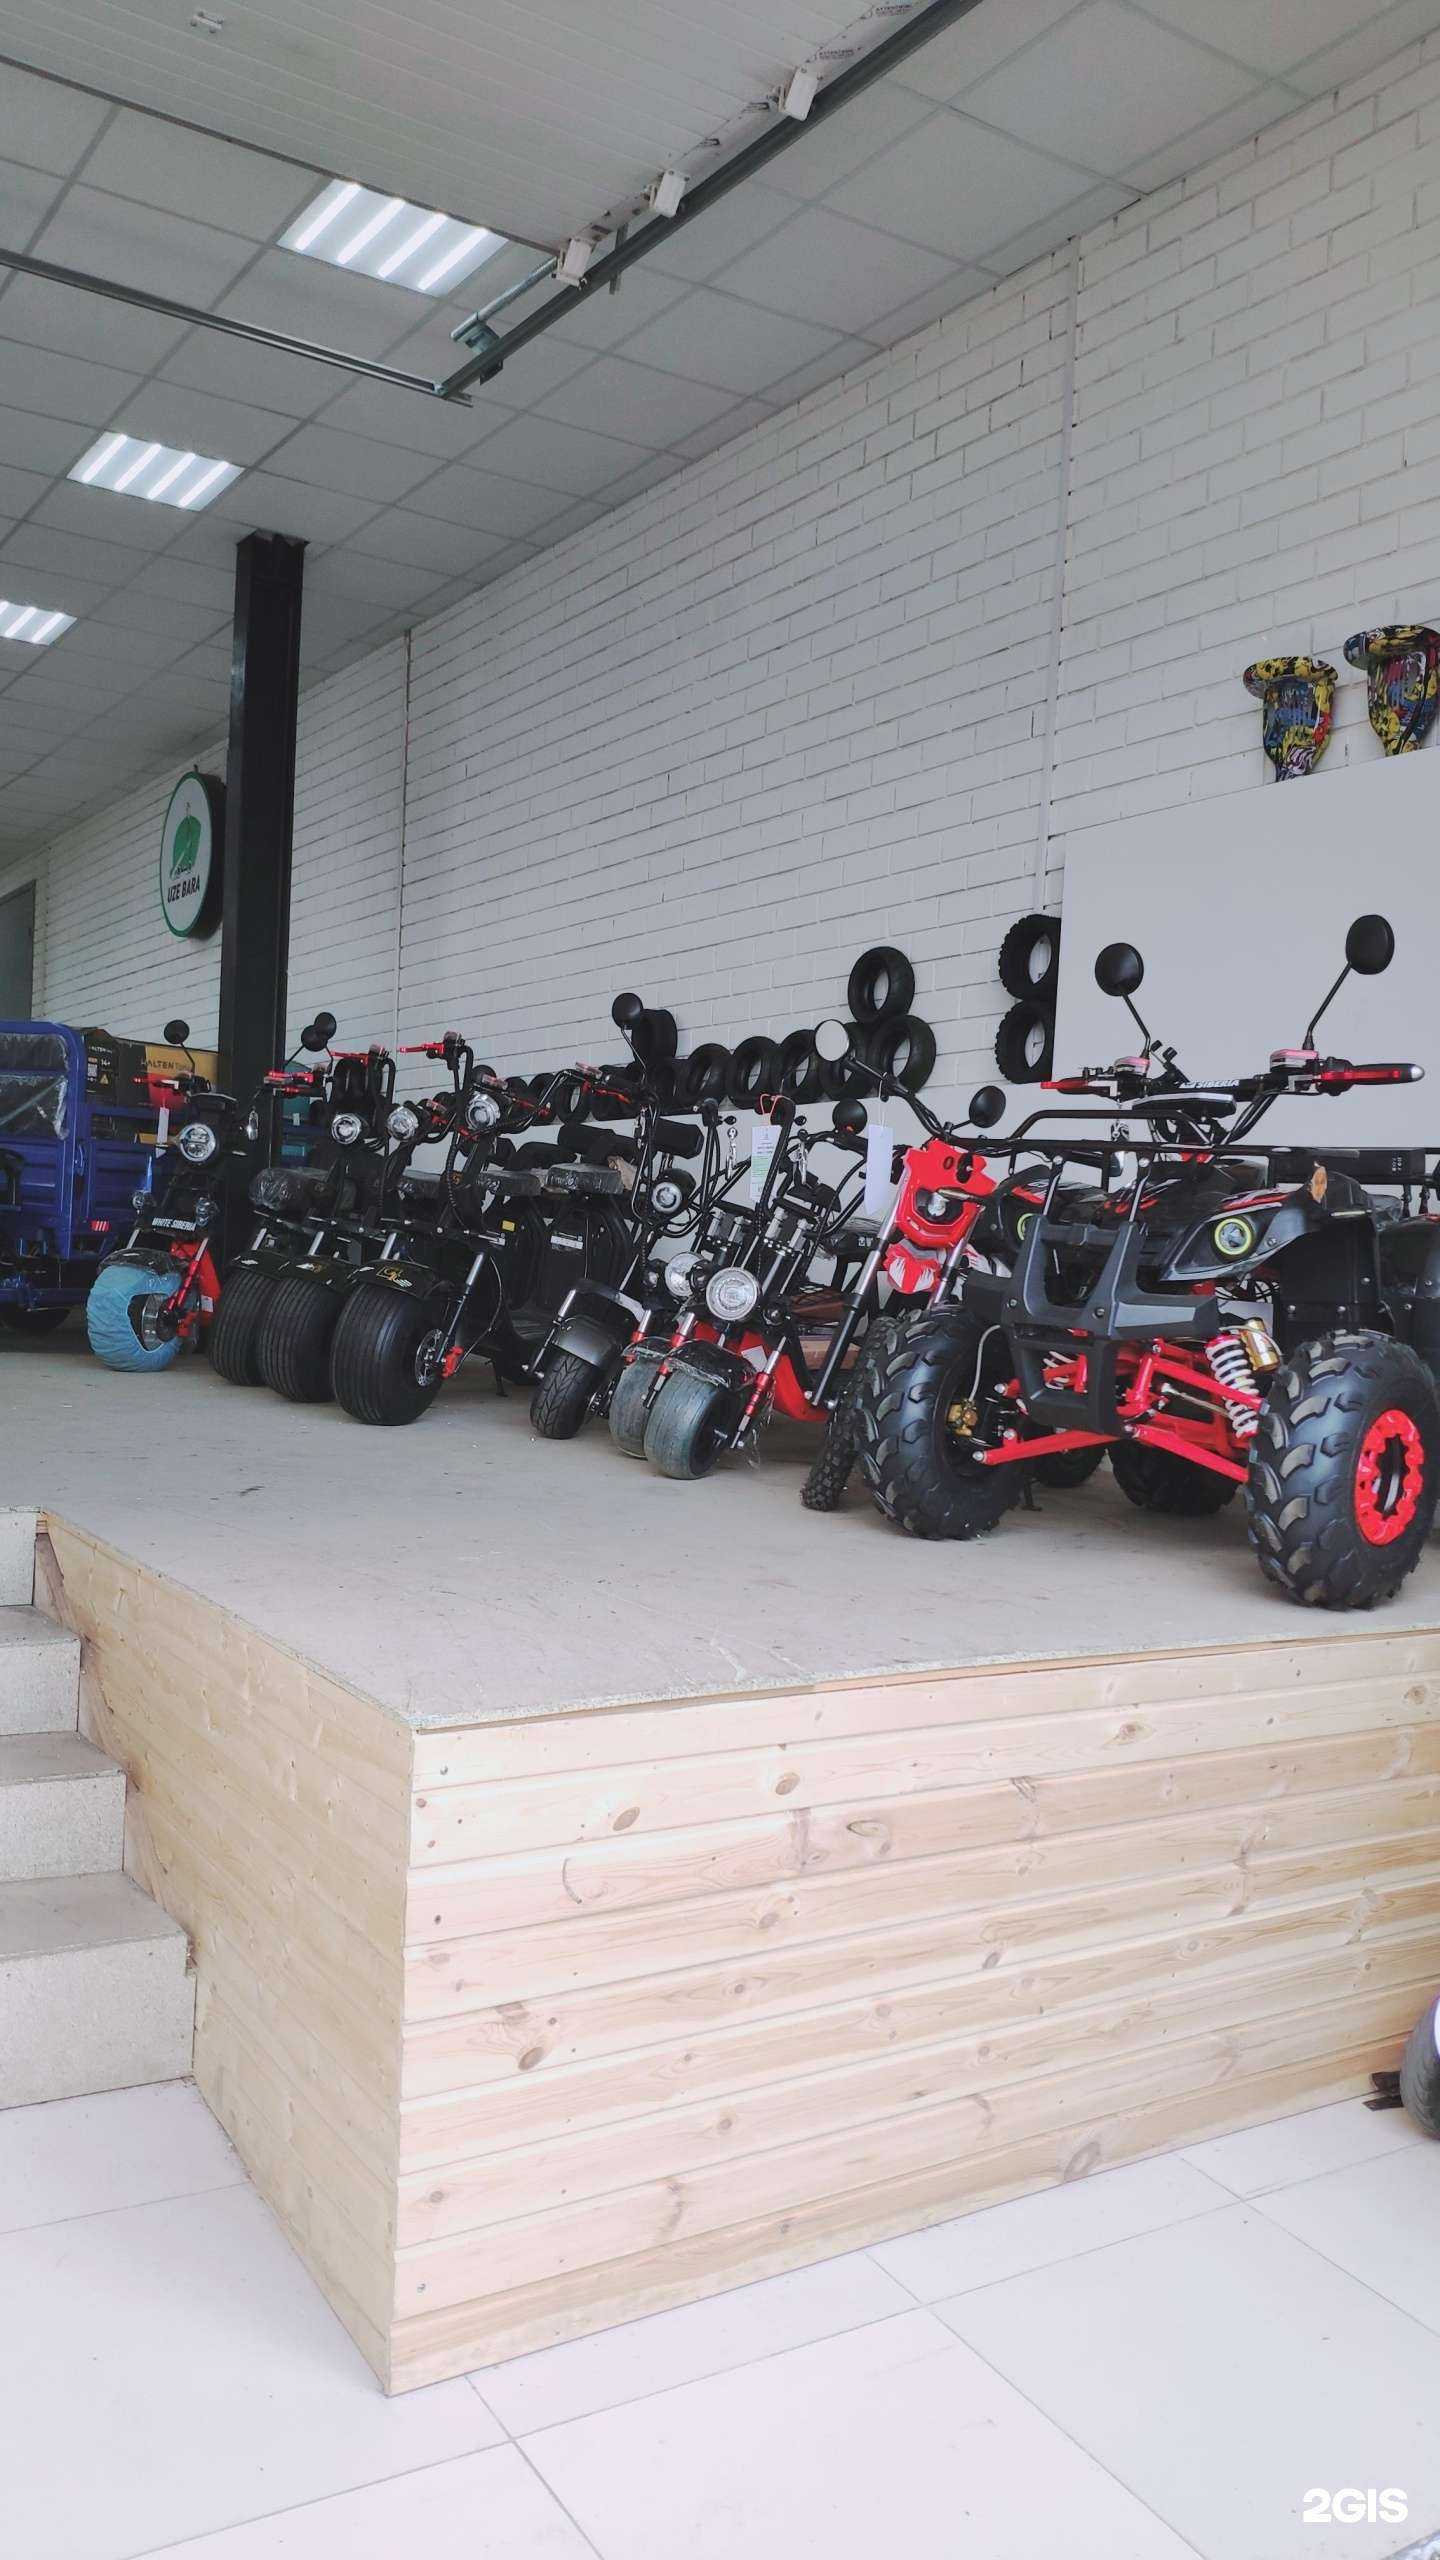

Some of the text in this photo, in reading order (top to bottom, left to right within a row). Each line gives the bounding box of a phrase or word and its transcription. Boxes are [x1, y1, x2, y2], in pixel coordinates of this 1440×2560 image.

[167, 875, 200, 903] UZE BARA
[152, 1217, 197, 1232] WHITE SIBERIA
